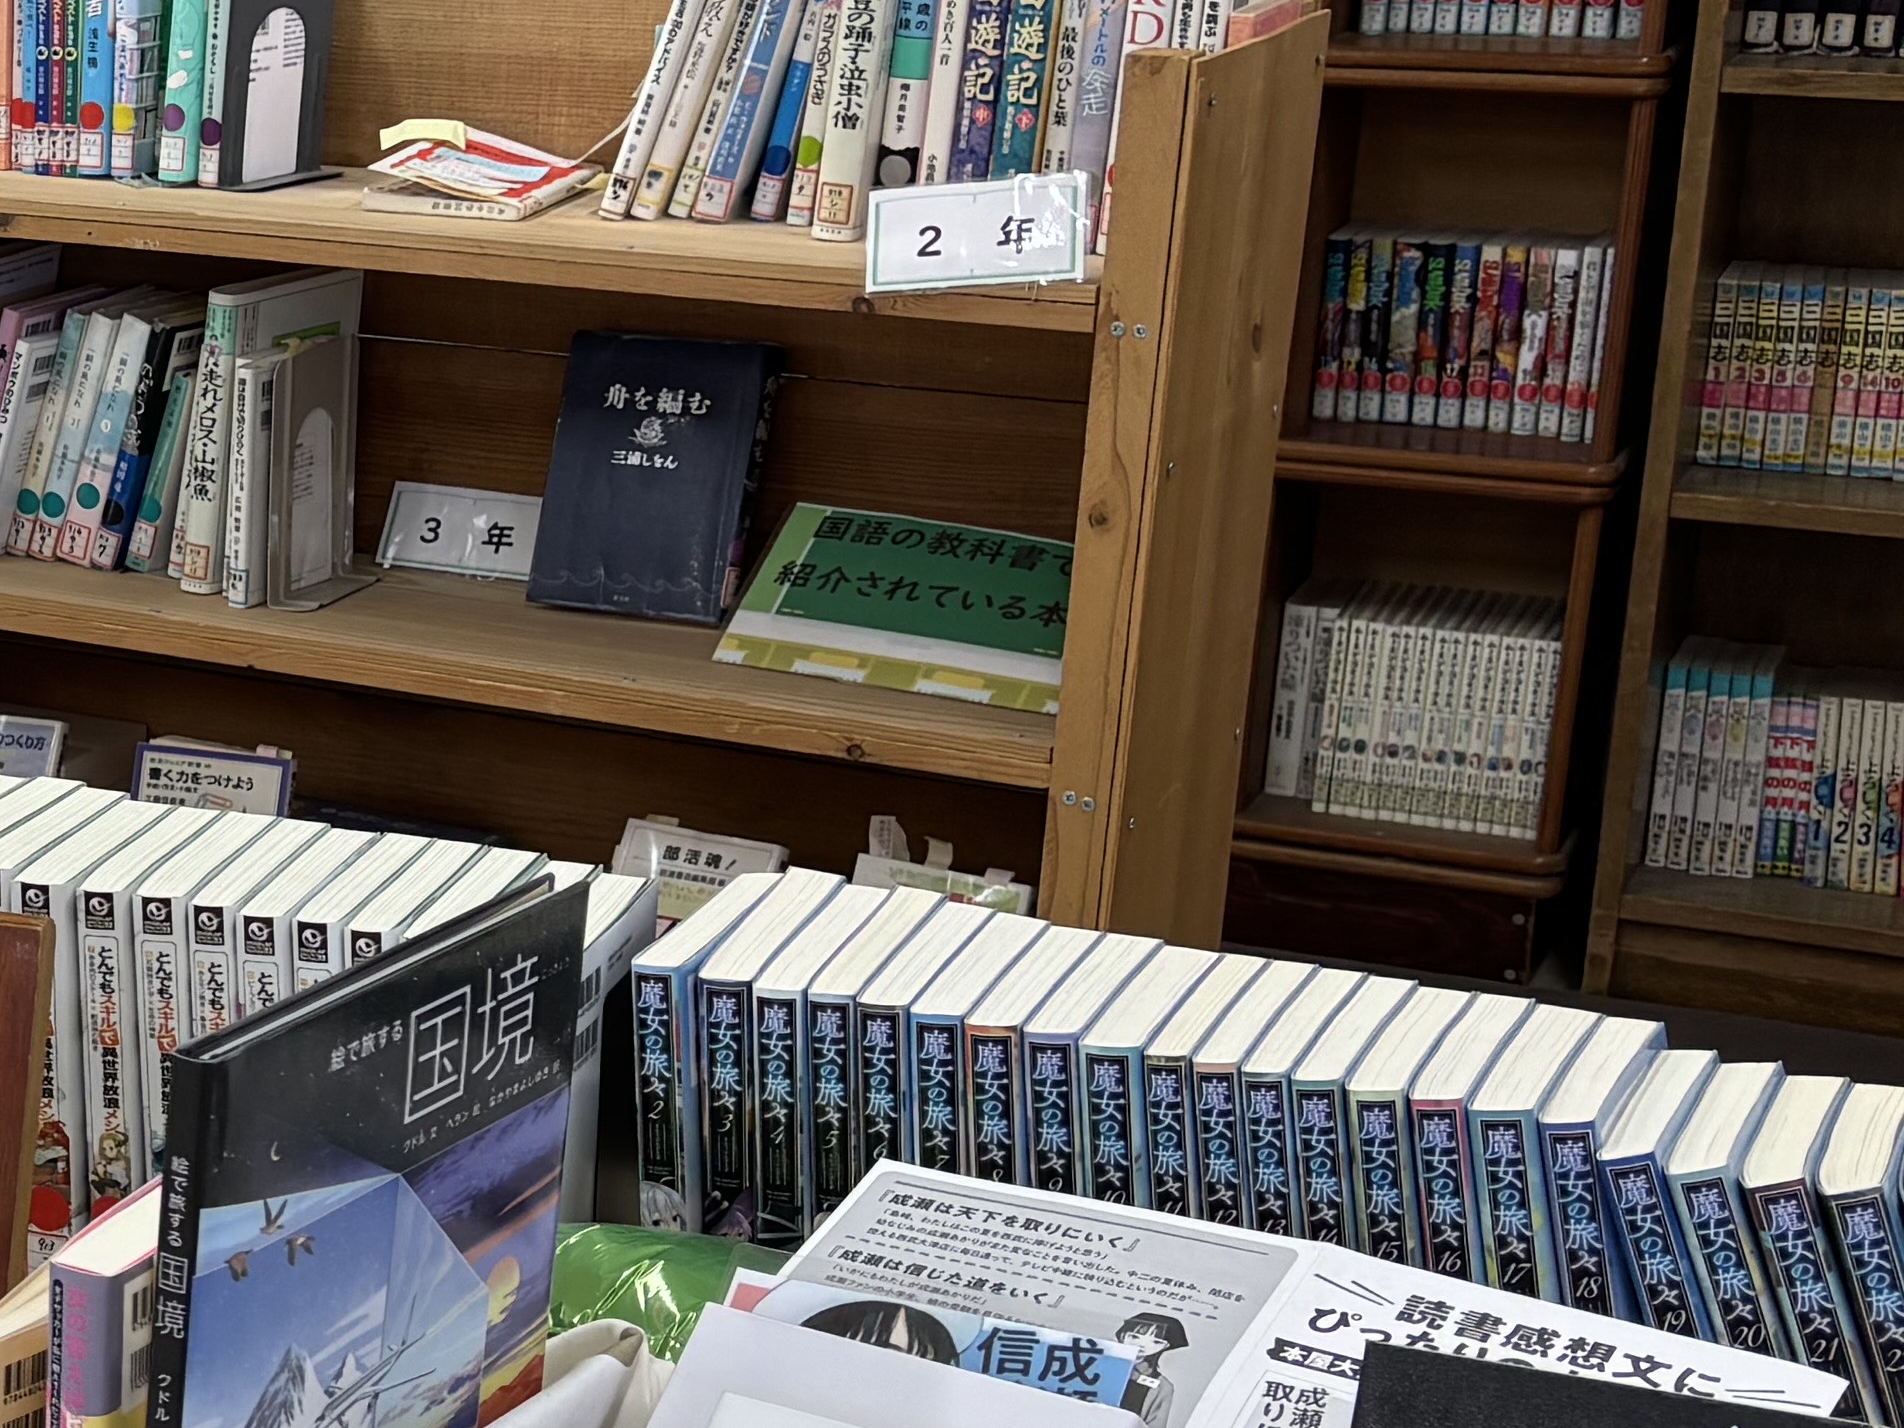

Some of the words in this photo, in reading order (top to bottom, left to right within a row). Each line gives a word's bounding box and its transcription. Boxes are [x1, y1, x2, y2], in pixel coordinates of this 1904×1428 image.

[1051, 25, 1080, 128] 最後のひと葉
[602, 382, 712, 418] 舟を編む
[609, 448, 680, 471] 三浦しをん
[812, 513, 1074, 577] 国語の教科書で
[774, 558, 1069, 630] 紹介されている本
[148, 766, 254, 792] 書く力をつけよう
[328, 1018, 405, 1073] 絵で旅する
[402, 954, 540, 1127] 国境
[638, 979, 669, 1101] 魔女の旅々
[1360, 1108, 1403, 1238] 魔女の旅々
[878, 1187, 1142, 1255] 『成瀬は天下を取りにいく』
[825, 1243, 1066, 1313] 『成瀬は信じた道をいく』
[1502, 1262, 1532, 1285] 17
[1575, 1275, 1601, 1300] 18
[1393, 1292, 1723, 1400] 読書感想文に
[1733, 1324, 1765, 1348] 20
[1811, 1336, 1840, 1363] 21
